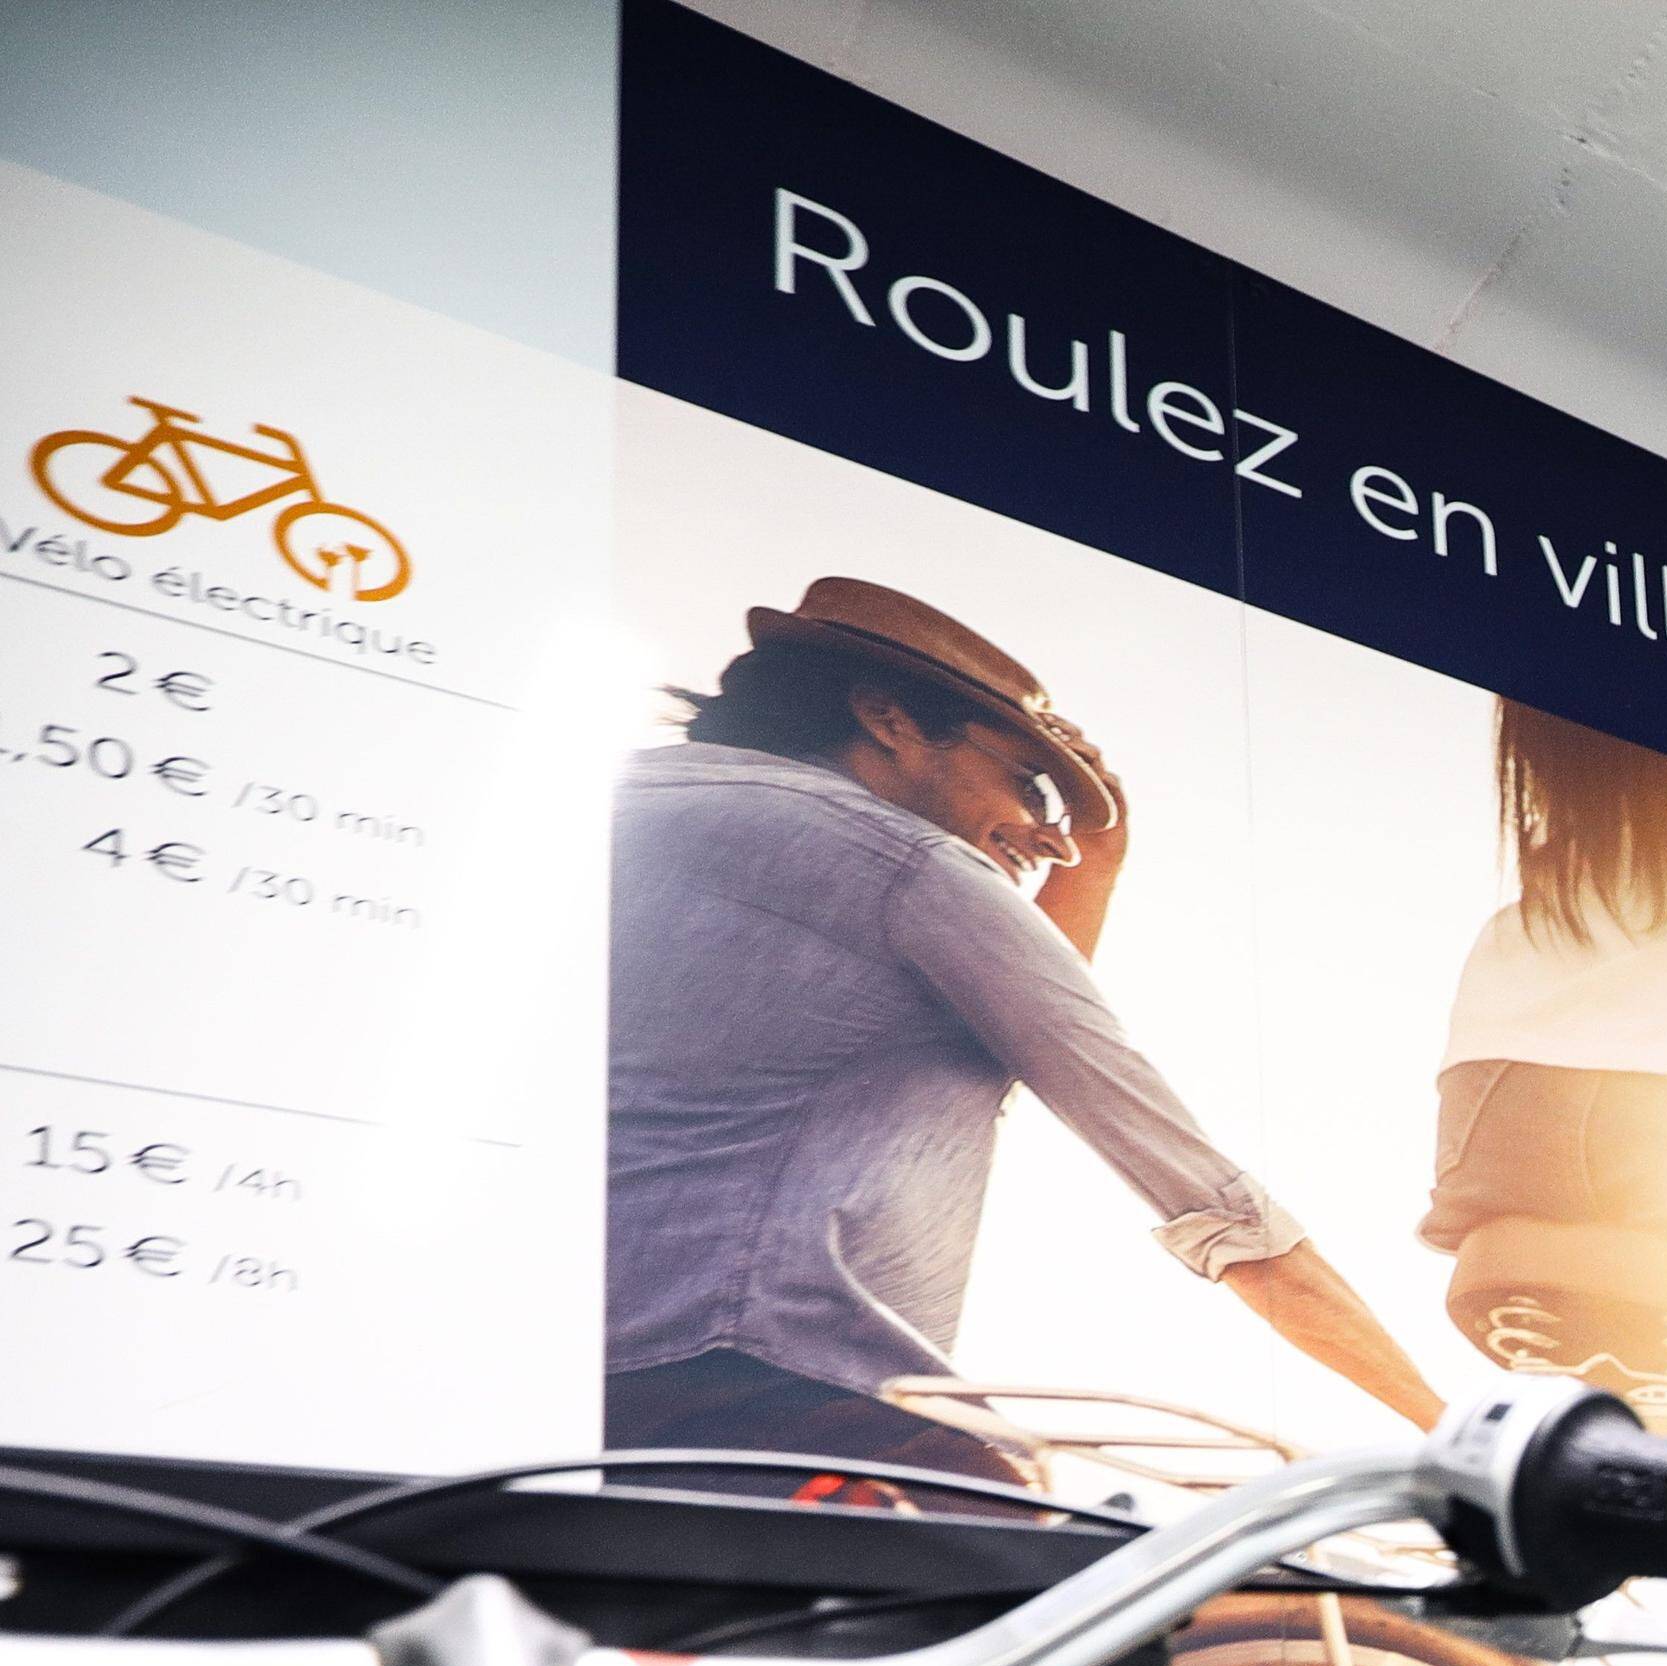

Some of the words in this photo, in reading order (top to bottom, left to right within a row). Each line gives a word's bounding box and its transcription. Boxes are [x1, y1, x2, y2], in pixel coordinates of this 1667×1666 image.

[774, 186, 1303, 499] Roulez
[1349, 464, 1498, 577] en
[0, 519, 132, 581] Vélo
[150, 565, 438, 665] électrique
[335, 811, 426, 848] min
[331, 895, 422, 930] min
[212, 1162, 302, 1202] /4h
[207, 1253, 300, 1293] /8h
